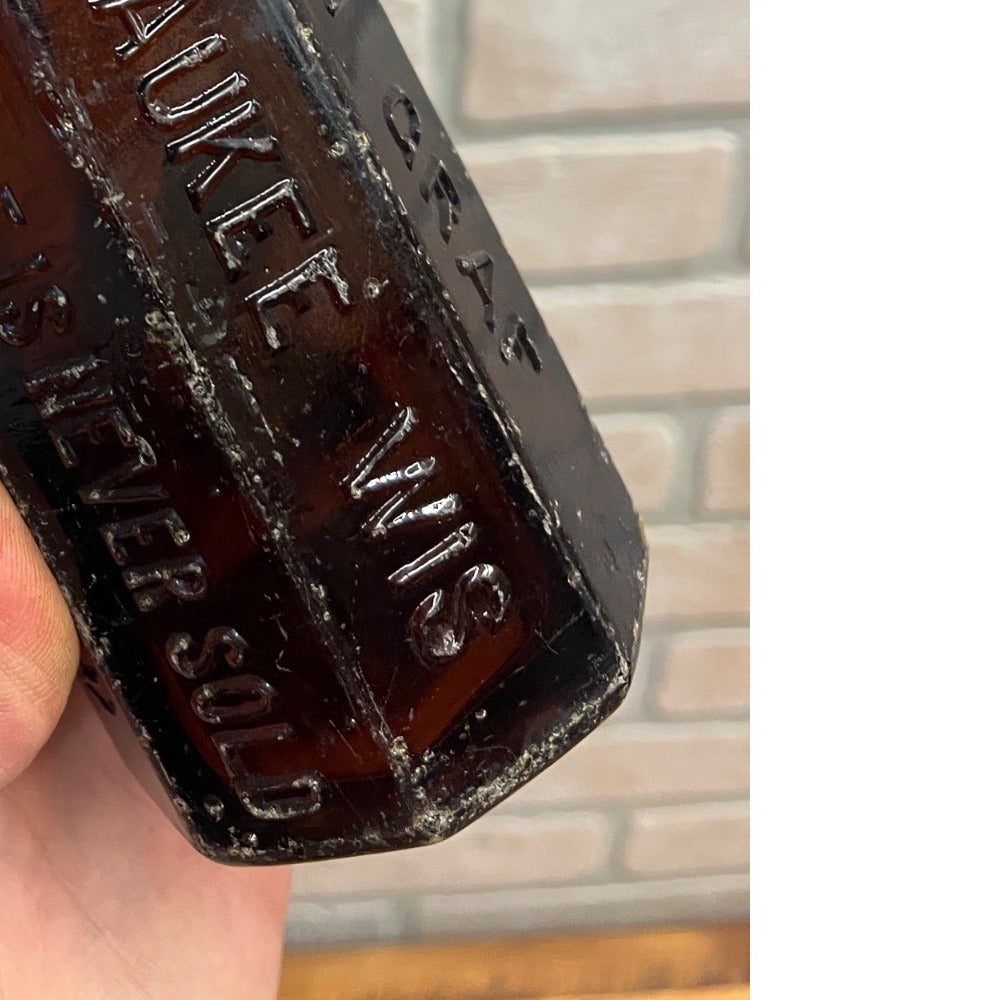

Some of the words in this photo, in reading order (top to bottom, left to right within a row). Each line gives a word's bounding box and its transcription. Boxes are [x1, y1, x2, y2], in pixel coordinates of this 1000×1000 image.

[25, 354, 208, 612] NEVER
[165, 626, 323, 819] SOLD
[340, 406, 511, 664] WIS
